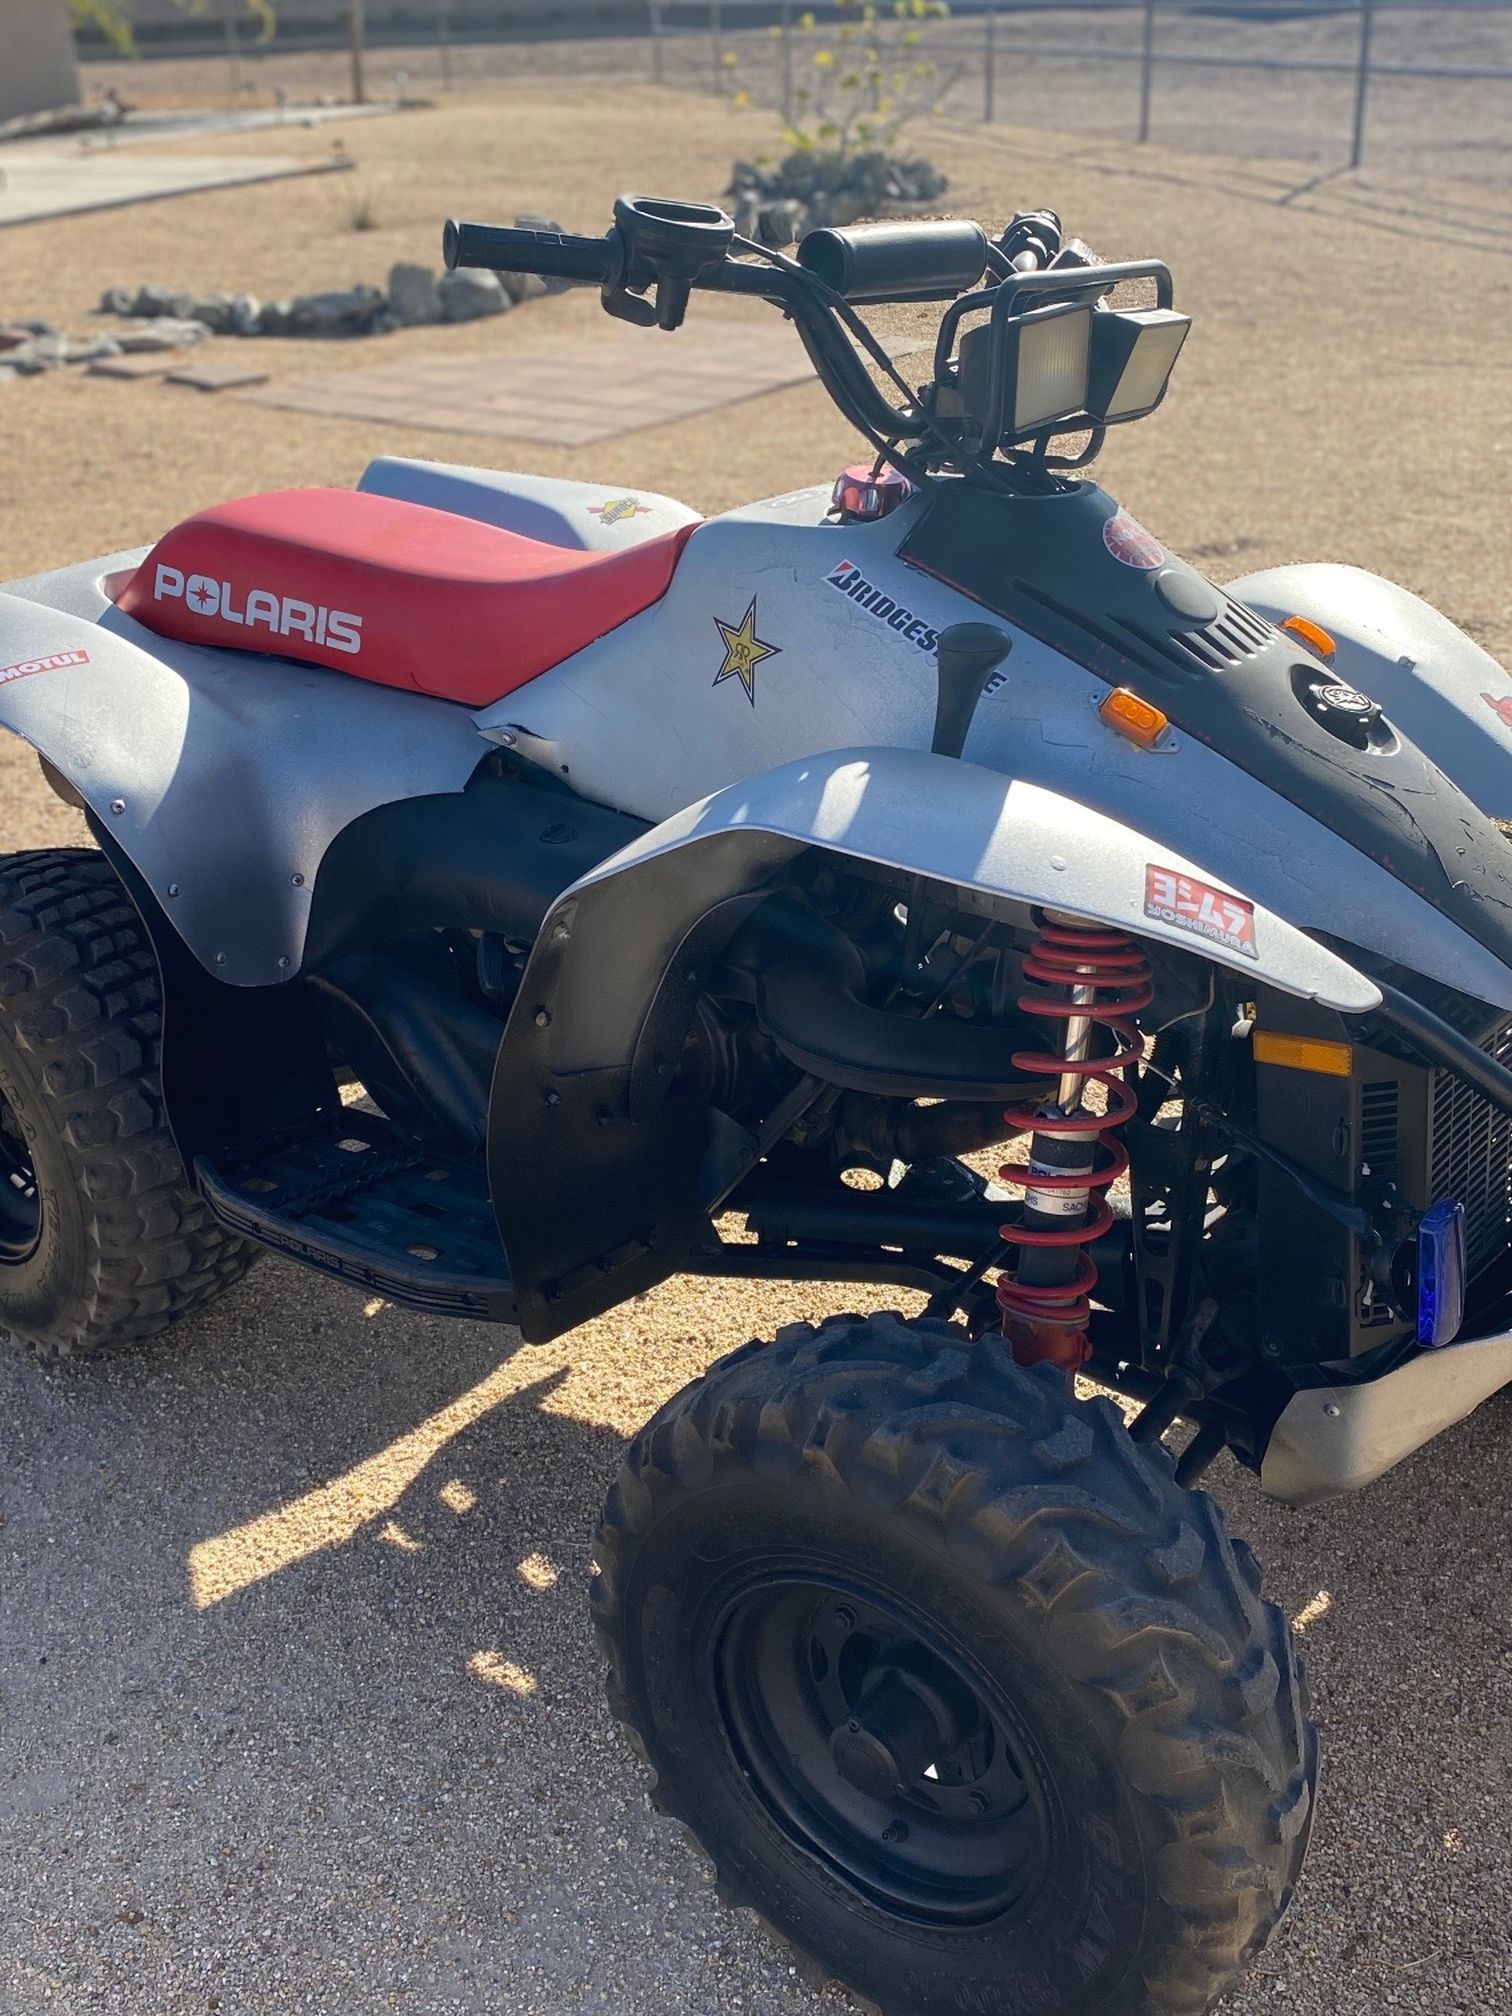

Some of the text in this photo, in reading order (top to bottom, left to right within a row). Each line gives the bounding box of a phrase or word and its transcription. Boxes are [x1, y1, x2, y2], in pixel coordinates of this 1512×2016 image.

[154, 563, 363, 654] POLARIS
[828, 562, 1007, 694] BRIDGESE
[0, 653, 86, 683] MOTUL
[1147, 903, 1255, 957] YOSHIMURA
[1153, 872, 1246, 934] ヨシムラ
